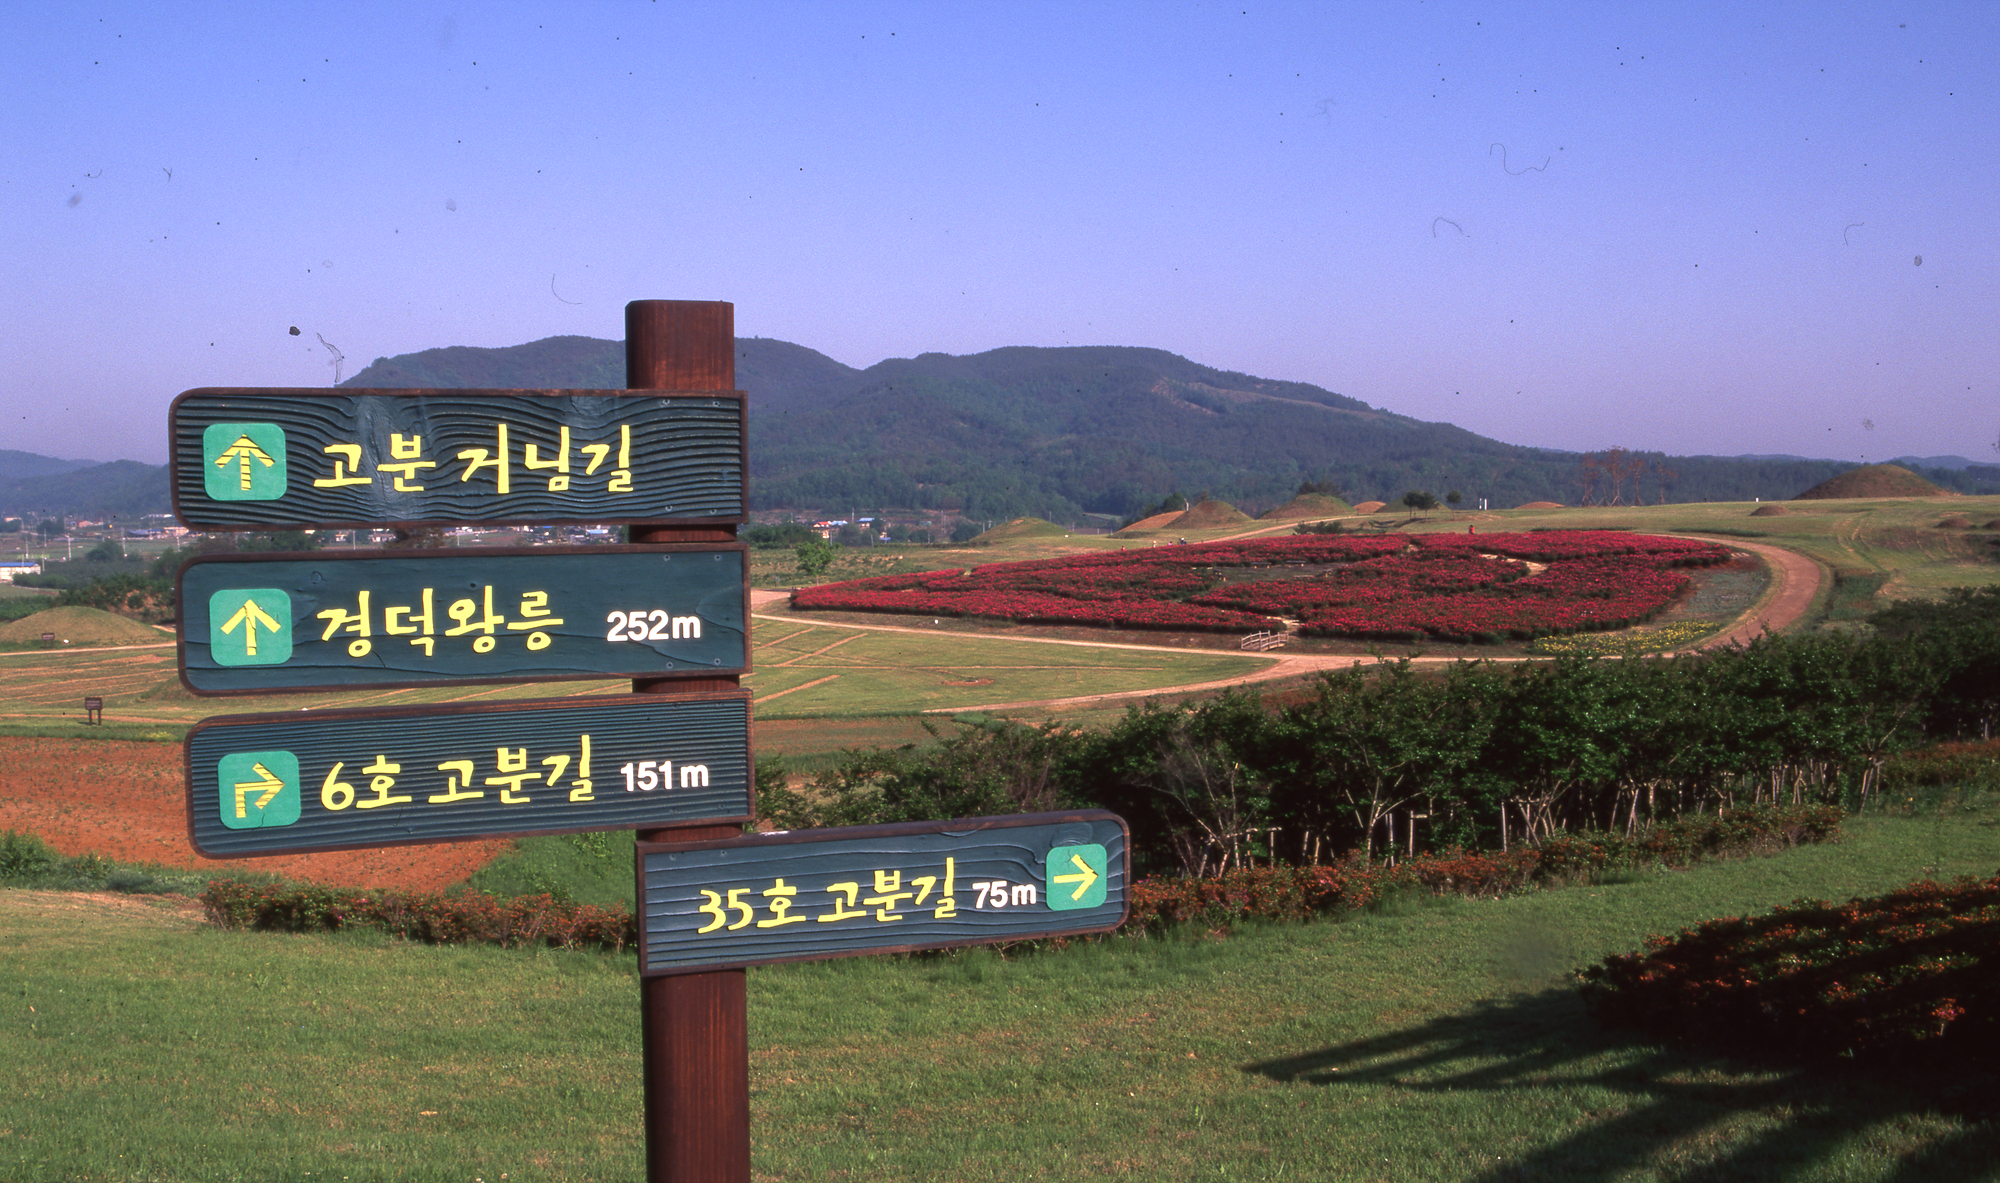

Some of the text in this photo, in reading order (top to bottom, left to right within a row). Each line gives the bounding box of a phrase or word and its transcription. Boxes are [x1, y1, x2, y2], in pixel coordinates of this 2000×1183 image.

[316, 584, 701, 658] 경덕왕릉 252m
[321, 754, 413, 811] 6호
[427, 734, 595, 804] 고분길
[697, 856, 1037, 934] 35호 고분길 75m
